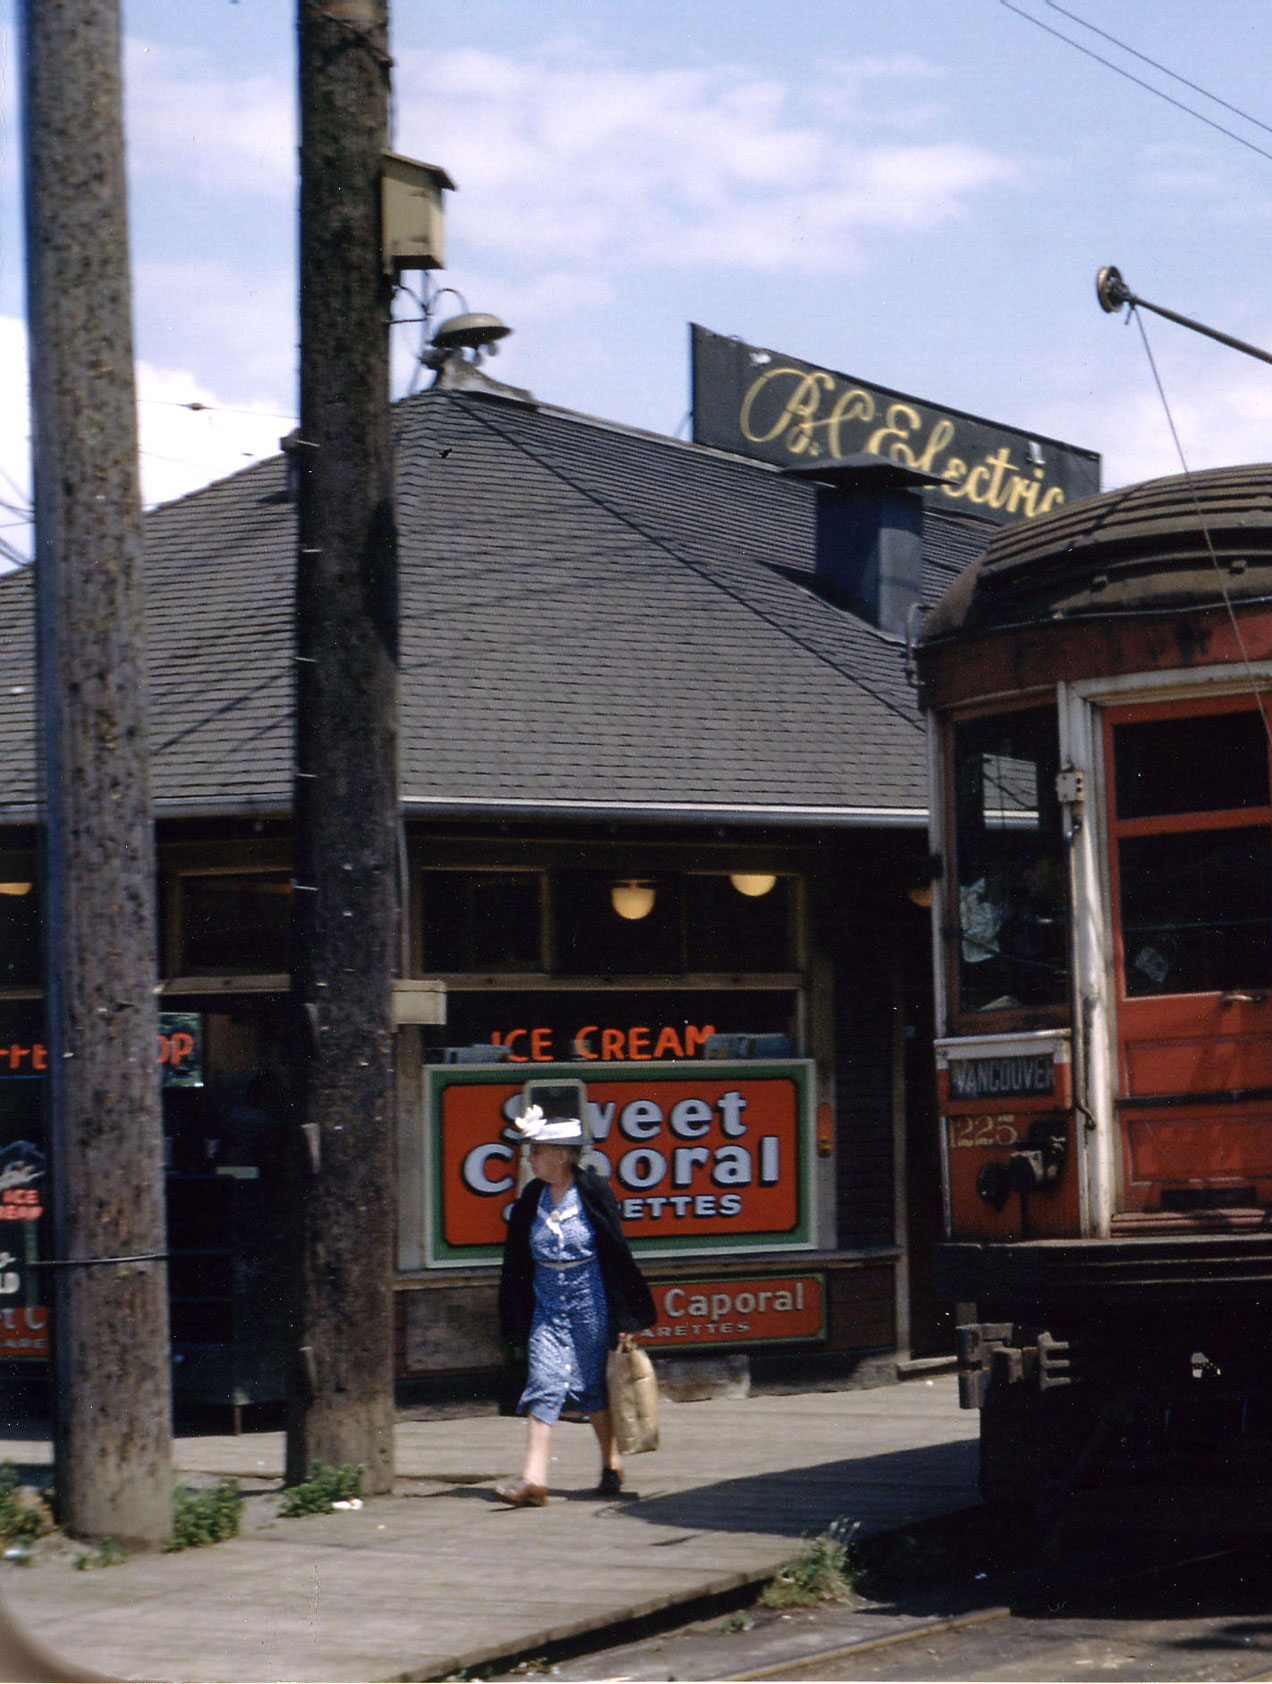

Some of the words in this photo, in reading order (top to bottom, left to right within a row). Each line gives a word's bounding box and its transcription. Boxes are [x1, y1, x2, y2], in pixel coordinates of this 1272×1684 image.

[491, 1028, 554, 1063] ICE
[574, 1025, 716, 1061] CREAM
[462, 1136, 780, 1194] Coral
[664, 1282, 805, 1321] Caporal
